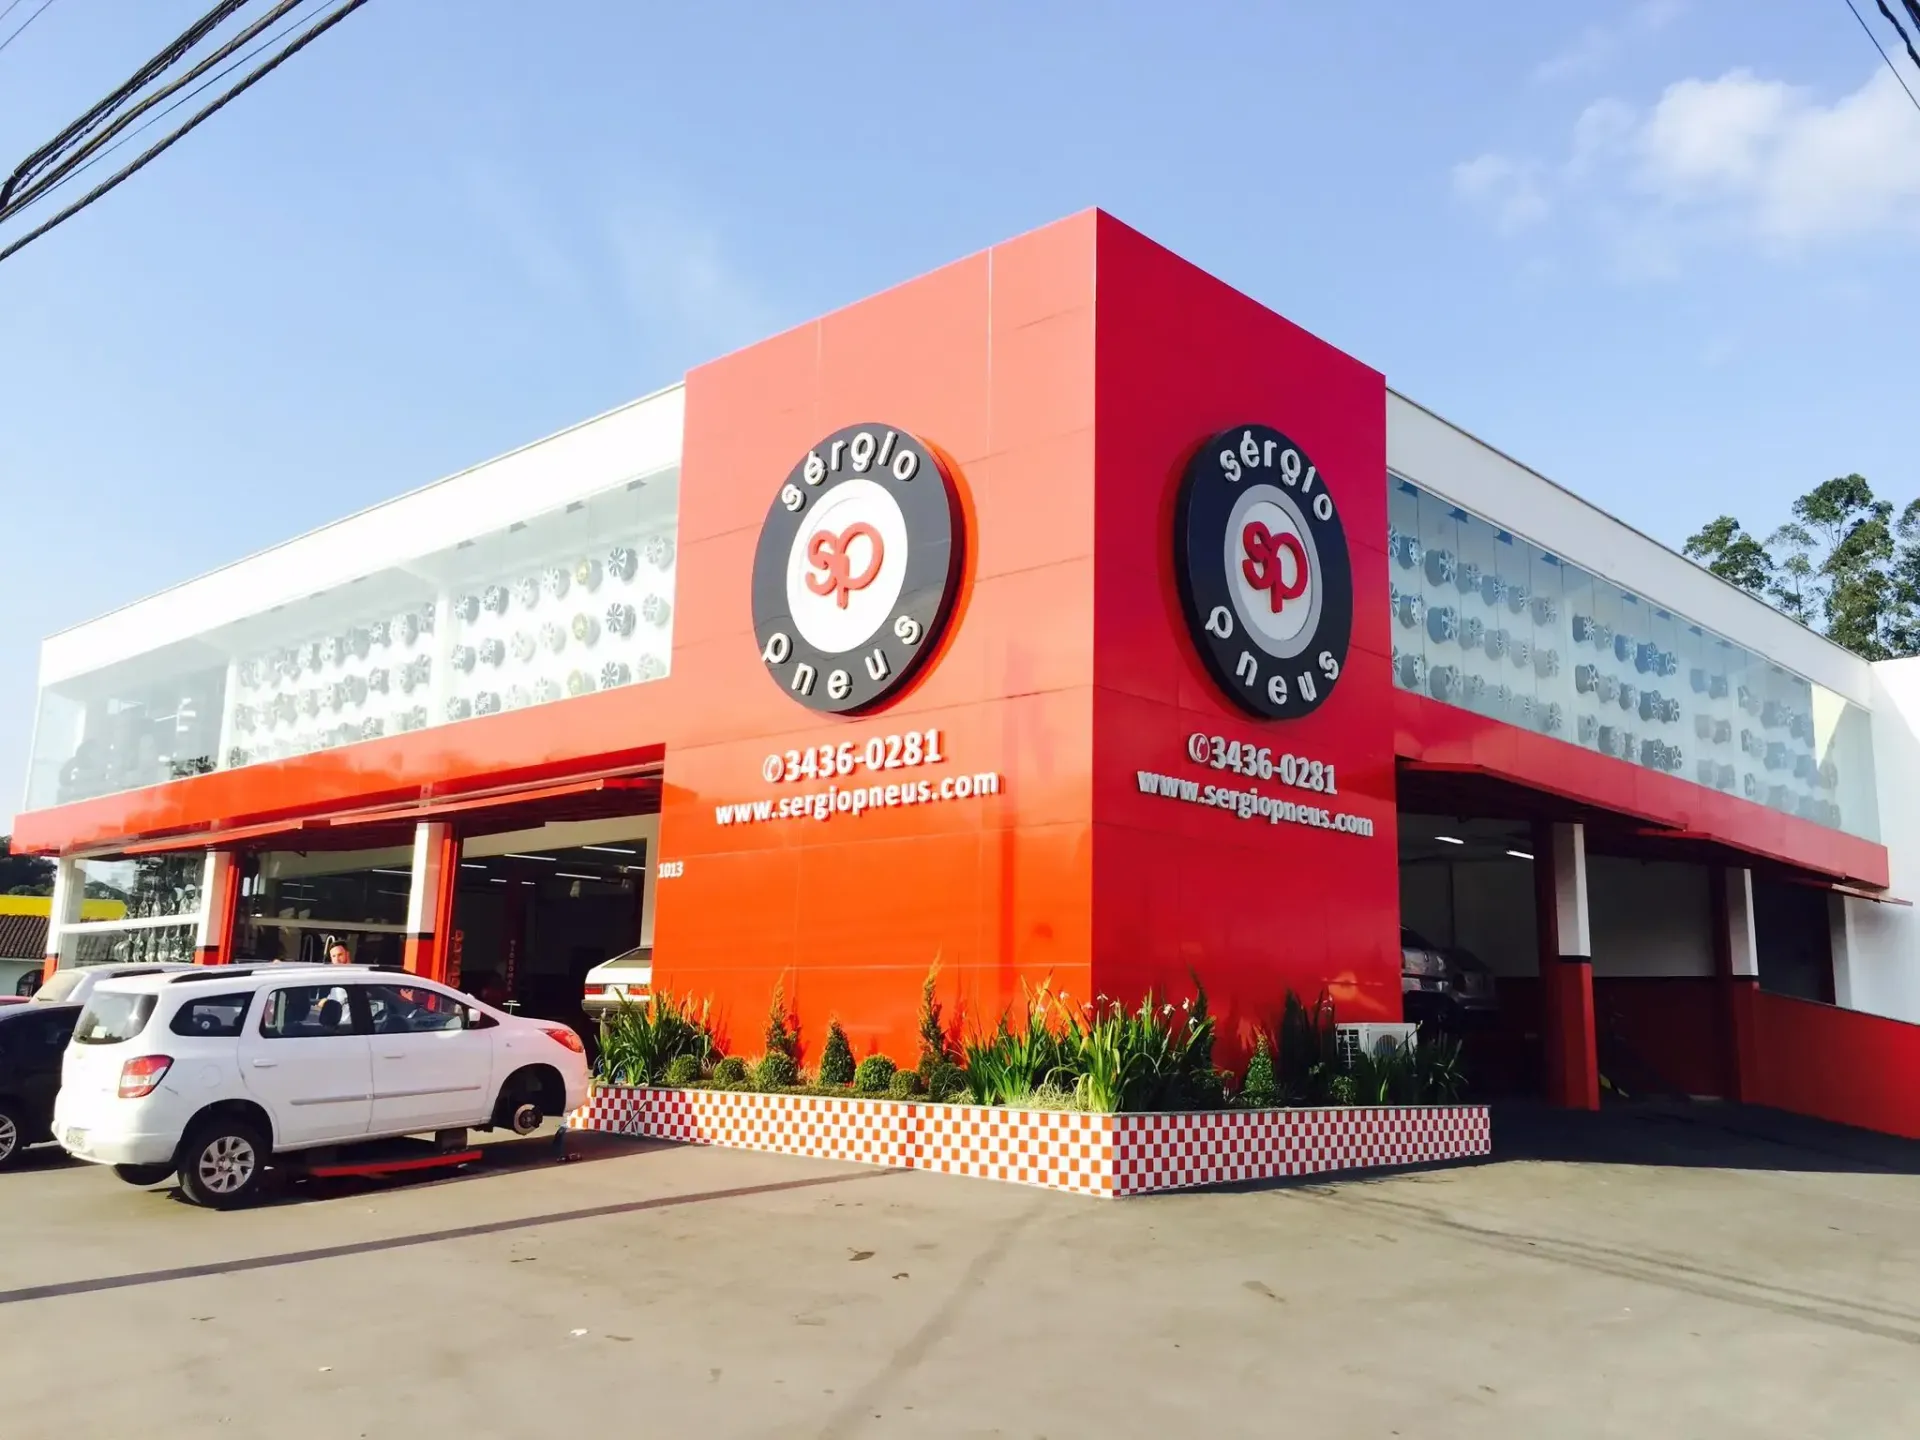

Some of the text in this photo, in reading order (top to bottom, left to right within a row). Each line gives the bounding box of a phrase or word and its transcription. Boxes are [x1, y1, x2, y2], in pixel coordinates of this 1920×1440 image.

[761, 614, 922, 700] pneus
[1204, 605, 1340, 705] pneus
[784, 728, 943, 782] 3436-0281
[1210, 735, 1338, 795] 3436-0281
[715, 771, 999, 825] www.sergiopneus.com
[1136, 770, 1374, 837] www.sergiopneus.com
[658, 860, 684, 879] 1013
